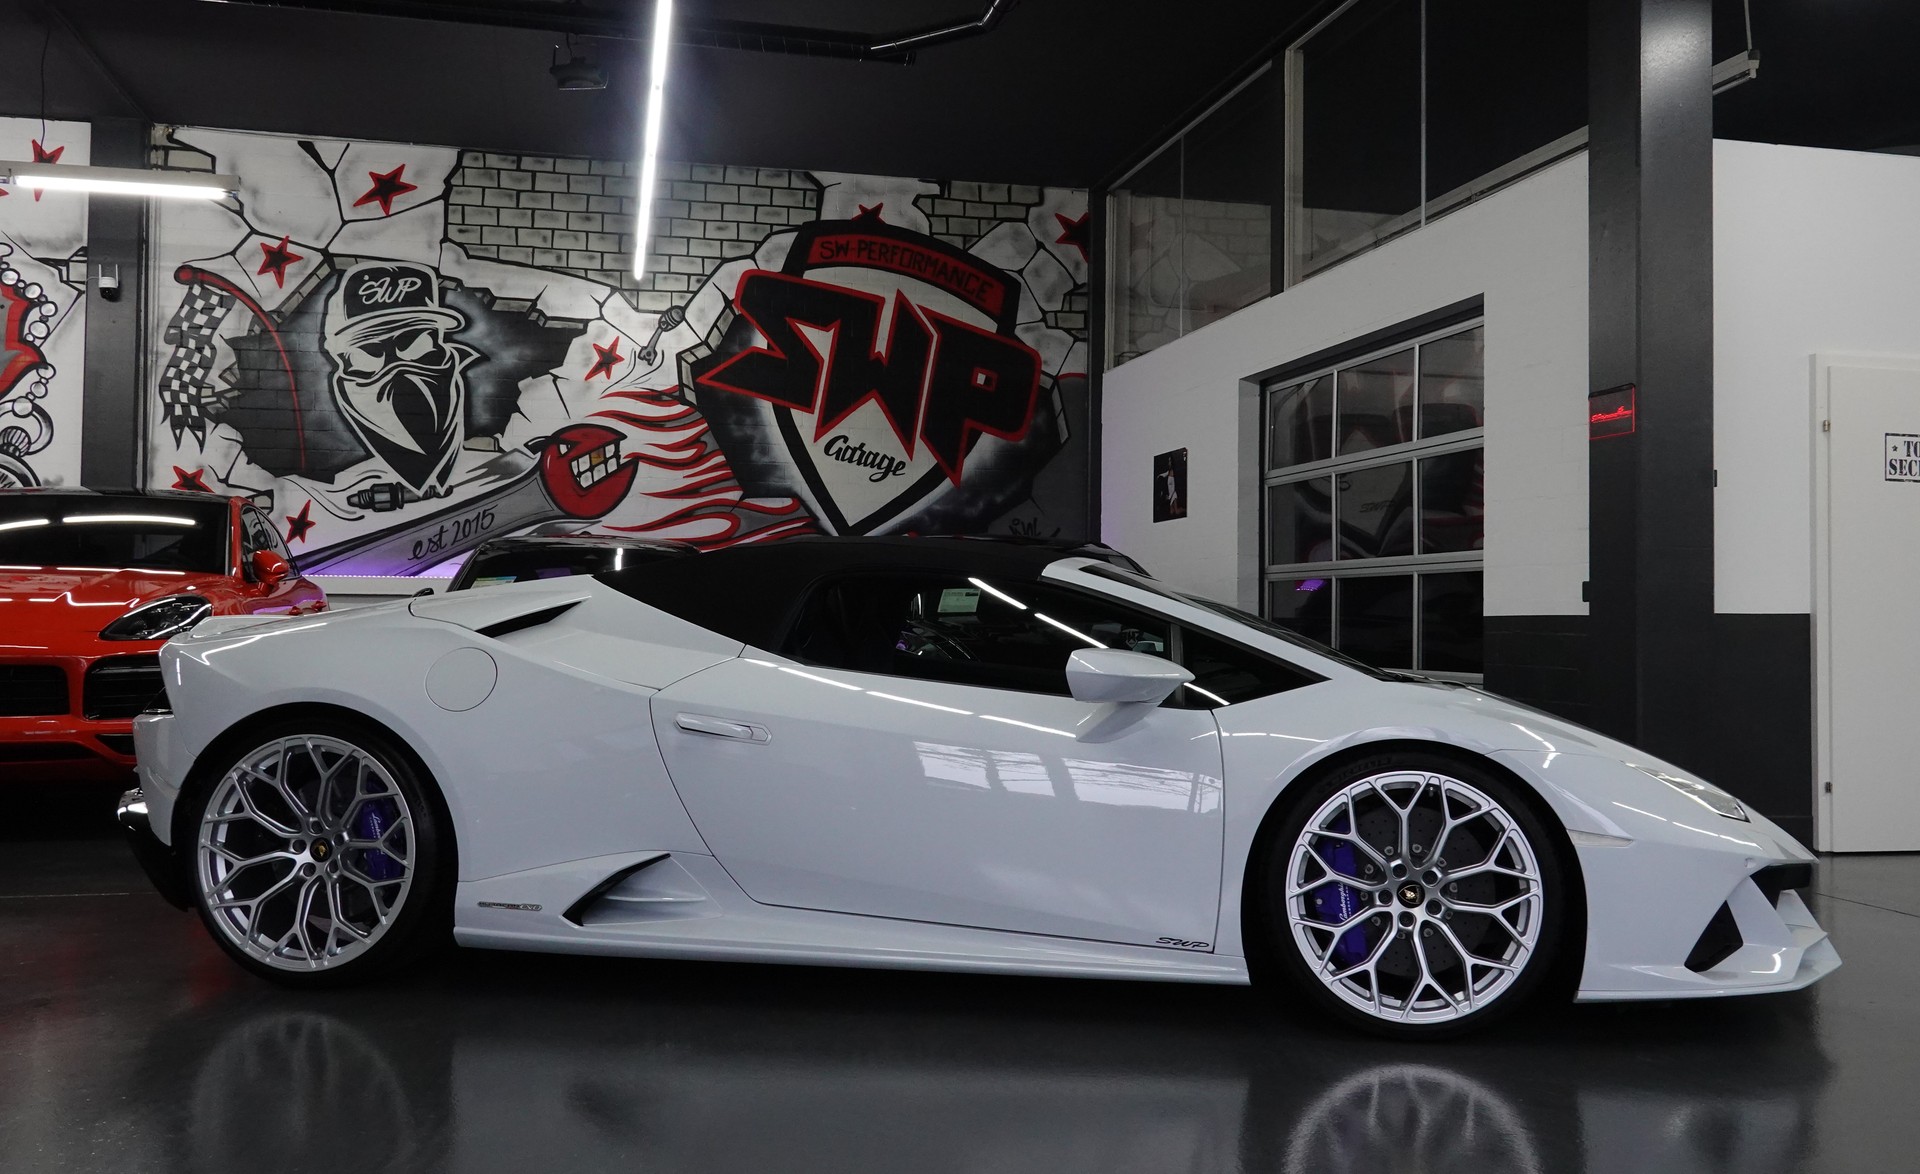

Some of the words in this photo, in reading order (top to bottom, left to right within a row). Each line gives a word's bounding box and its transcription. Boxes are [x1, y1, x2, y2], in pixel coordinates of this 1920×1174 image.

[358, 275, 422, 305] SWP
[820, 238, 994, 300] SW-PERFORMANCE
[696, 268, 1042, 488] SWP
[823, 435, 906, 482] Garage
[1888, 458, 1920, 476] SEC
[408, 525, 449, 562] est
[451, 504, 498, 546] 2015
